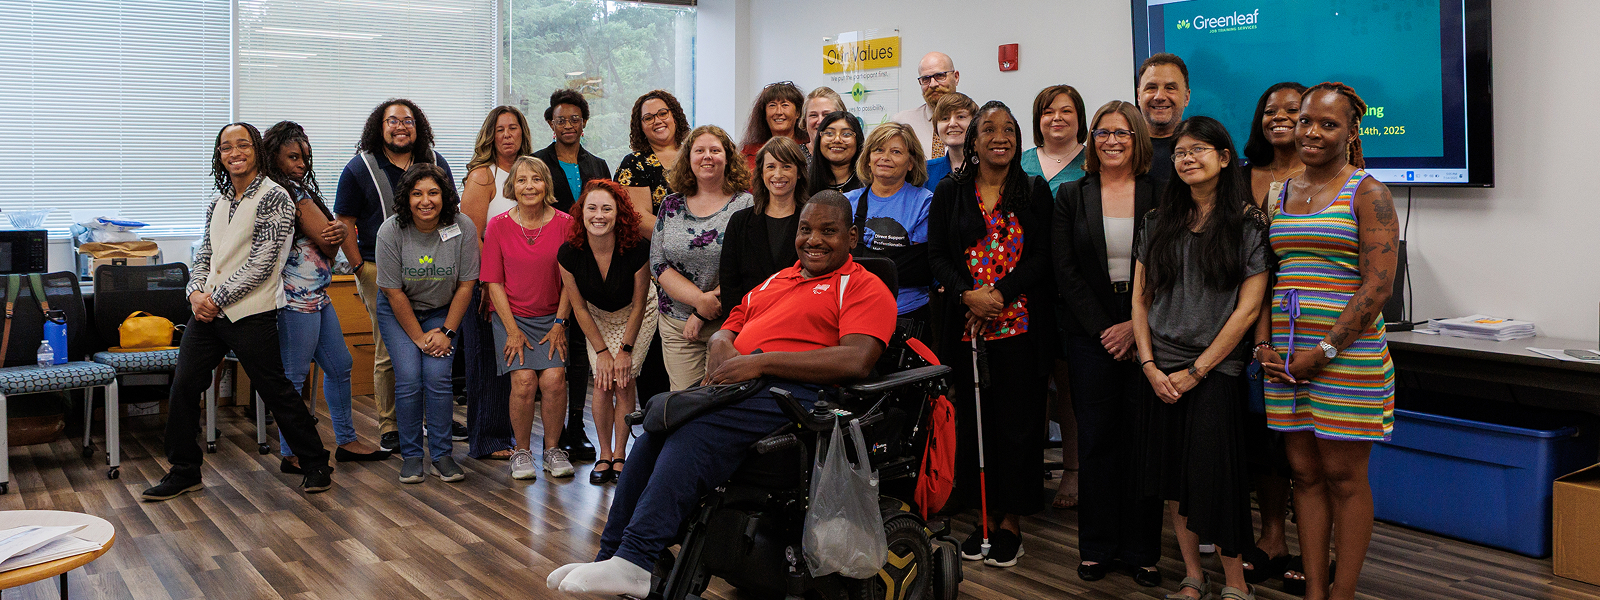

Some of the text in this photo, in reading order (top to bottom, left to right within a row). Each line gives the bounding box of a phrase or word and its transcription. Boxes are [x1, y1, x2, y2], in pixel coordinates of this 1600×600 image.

[1193, 8, 1259, 29] Greenleaf
[852, 44, 893, 62] Values
[1364, 104, 1384, 118] ing
[1359, 126, 1405, 136] 14th, 2025
